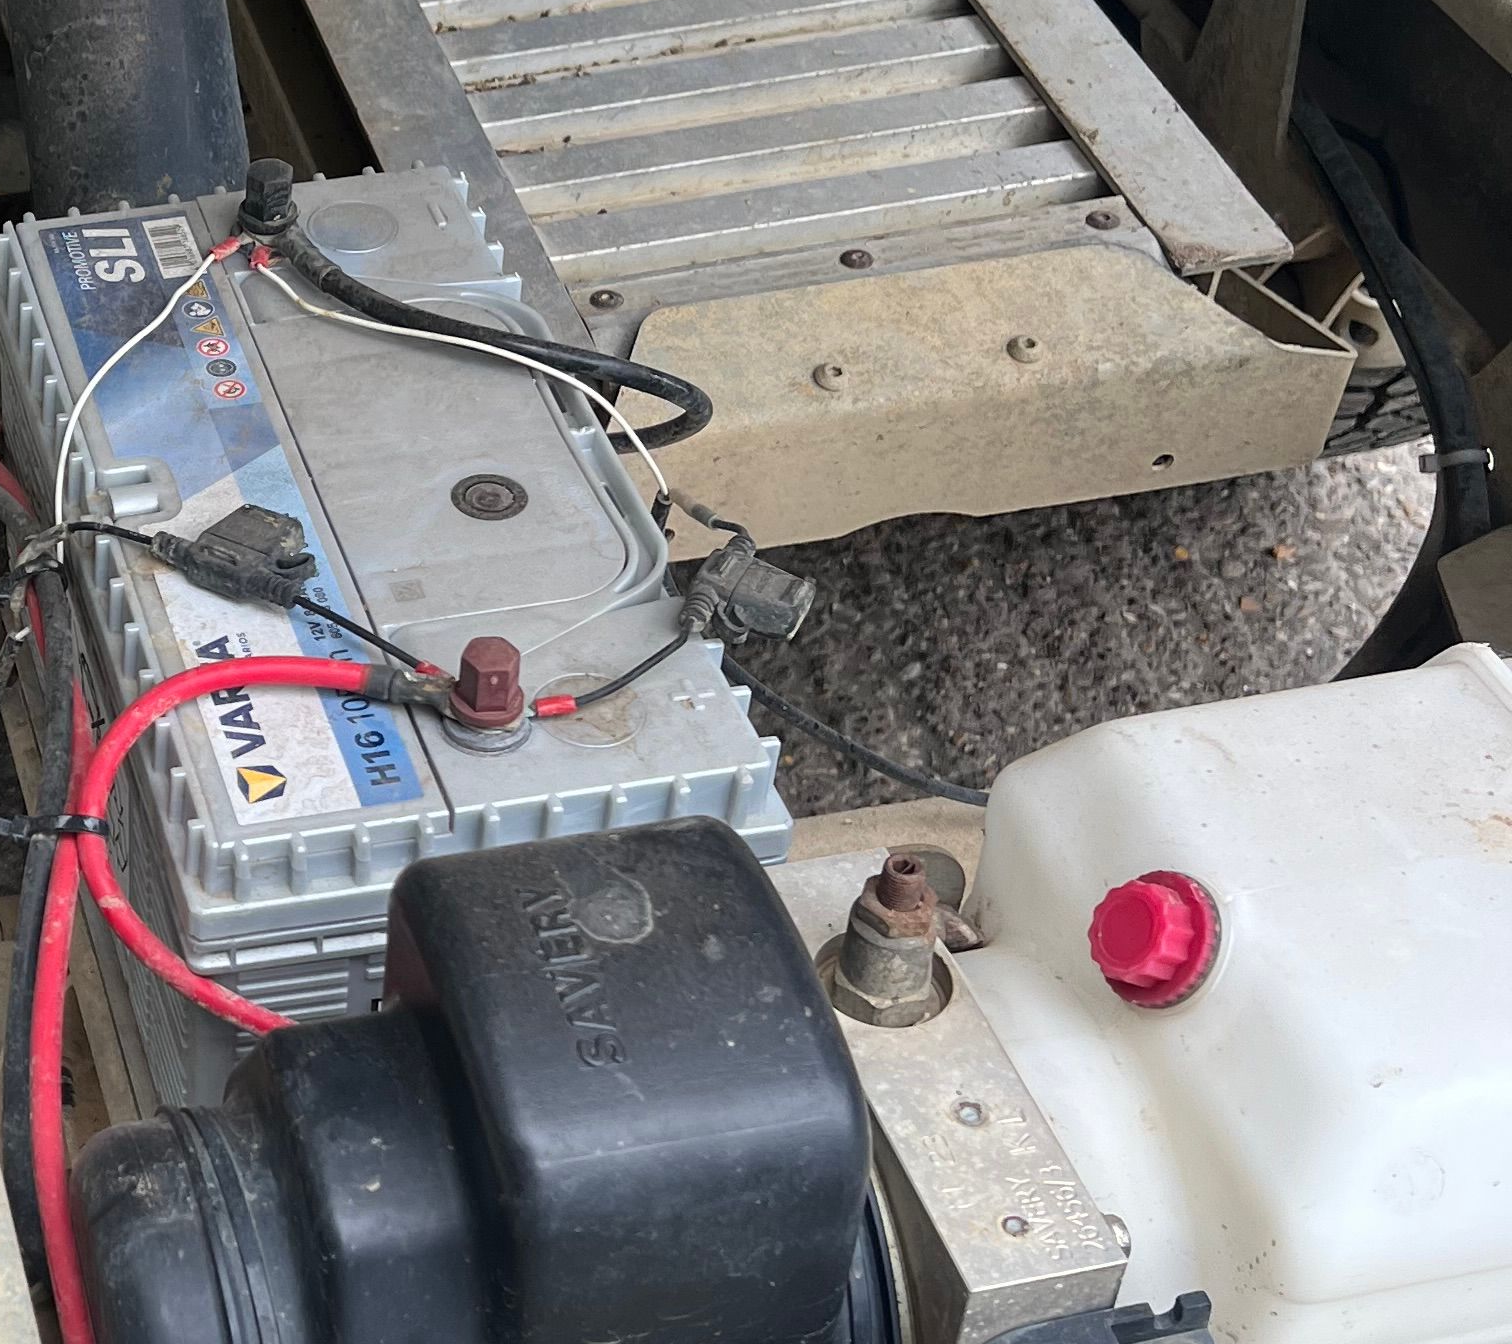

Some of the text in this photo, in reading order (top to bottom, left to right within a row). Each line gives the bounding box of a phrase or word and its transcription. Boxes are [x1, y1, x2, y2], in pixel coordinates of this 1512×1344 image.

[62, 231, 96, 291] PROMOTIVE
[82, 228, 146, 283] SLI
[235, 632, 252, 657] ARIOS
[307, 622, 326, 641] 12V
[195, 636, 267, 759] VARA
[355, 730, 401, 786] H16
[516, 888, 627, 1068] SAVERY
[1004, 1176, 1070, 1260] SAVERY
